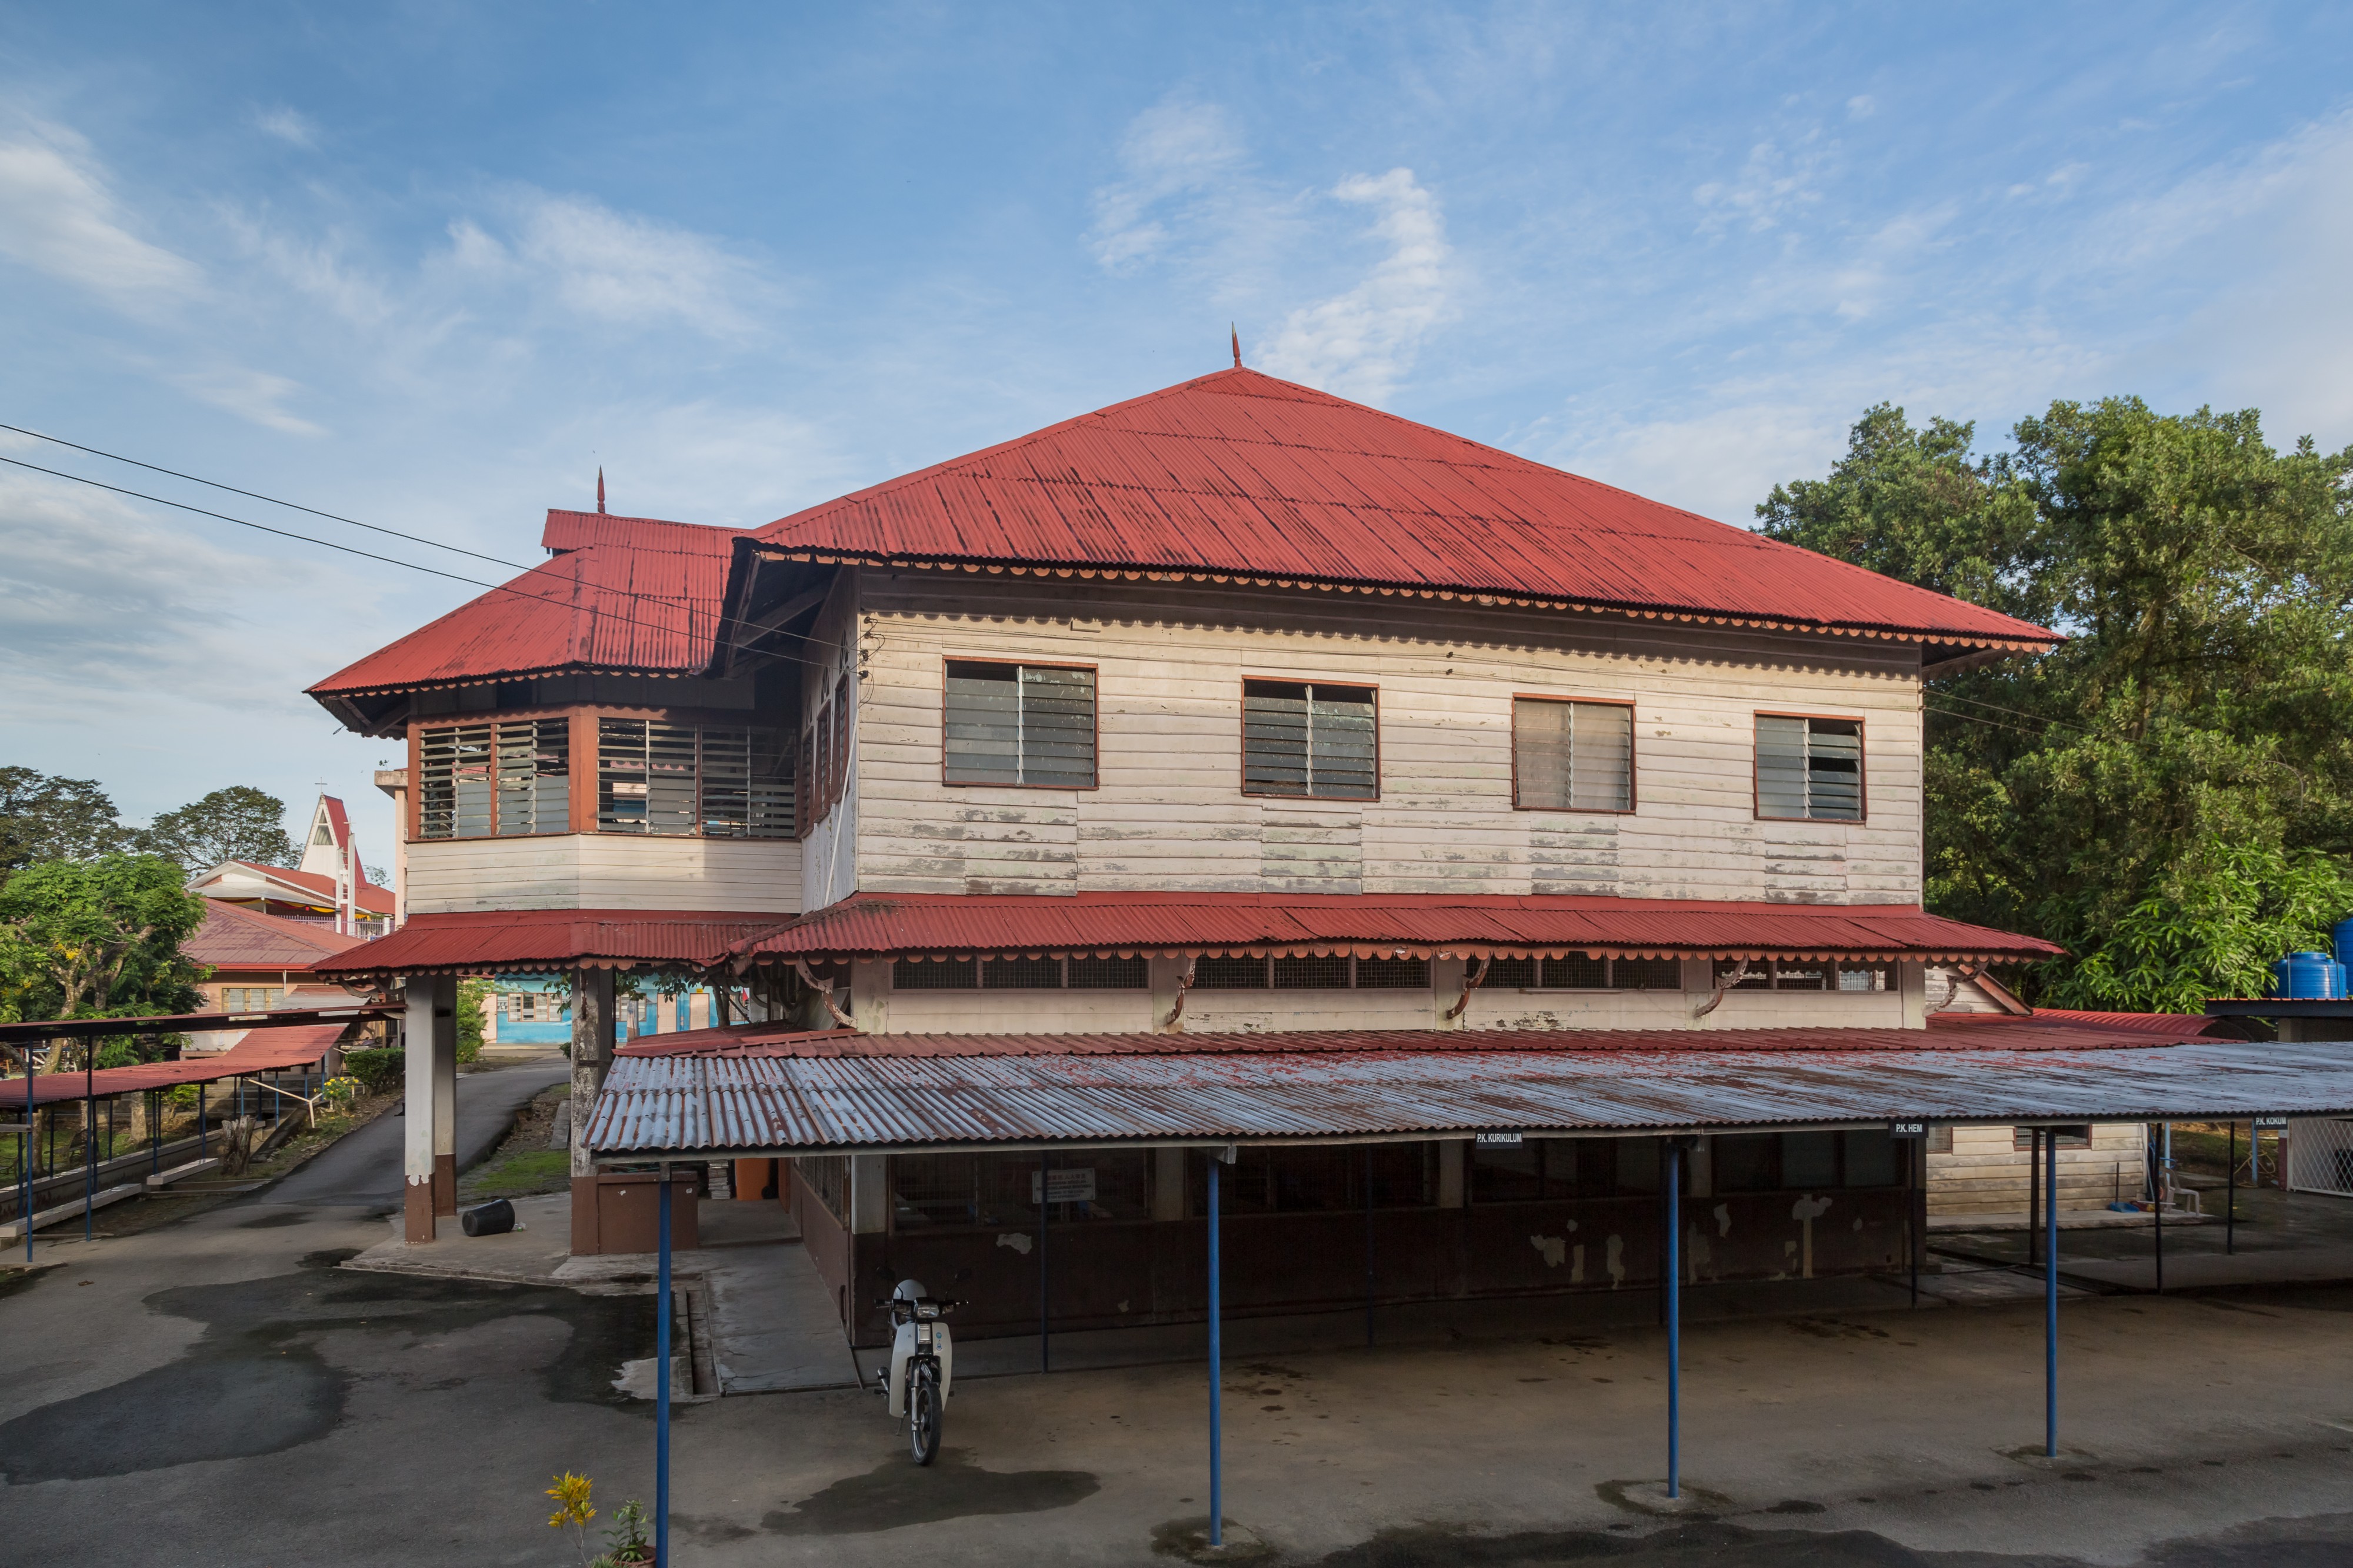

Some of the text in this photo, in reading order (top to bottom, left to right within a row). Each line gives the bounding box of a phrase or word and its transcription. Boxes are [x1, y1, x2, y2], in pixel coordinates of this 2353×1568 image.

[2256, 1117, 2286, 1125] P.K. KOKUM
[1896, 1124, 1922, 1132] P.K. HEM
[1477, 1133, 1522, 1143] P.K. KURIKULUM
